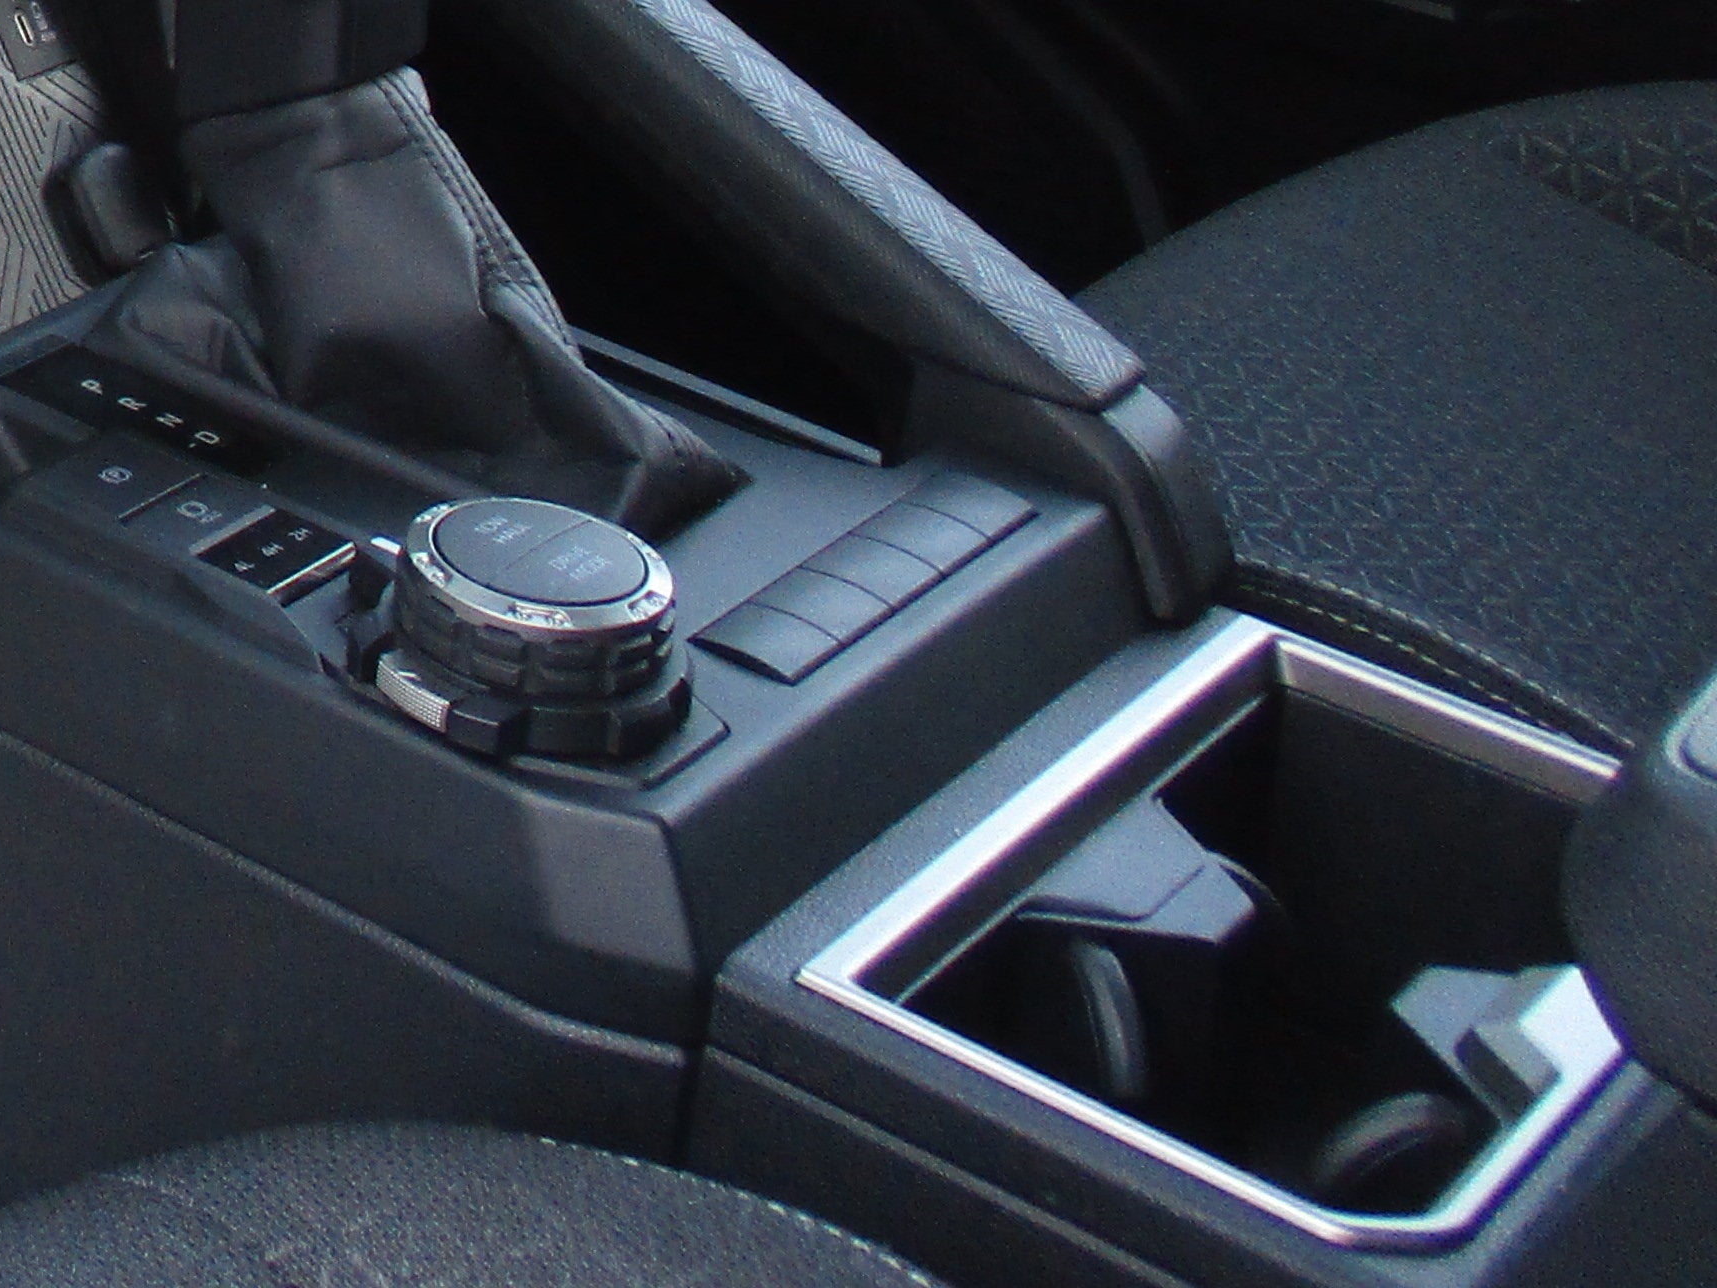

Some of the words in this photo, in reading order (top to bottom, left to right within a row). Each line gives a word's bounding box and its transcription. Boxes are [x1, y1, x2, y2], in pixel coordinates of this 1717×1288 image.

[80, 378, 103, 396] P
[117, 396, 148, 412] R
[194, 430, 222, 445] D
